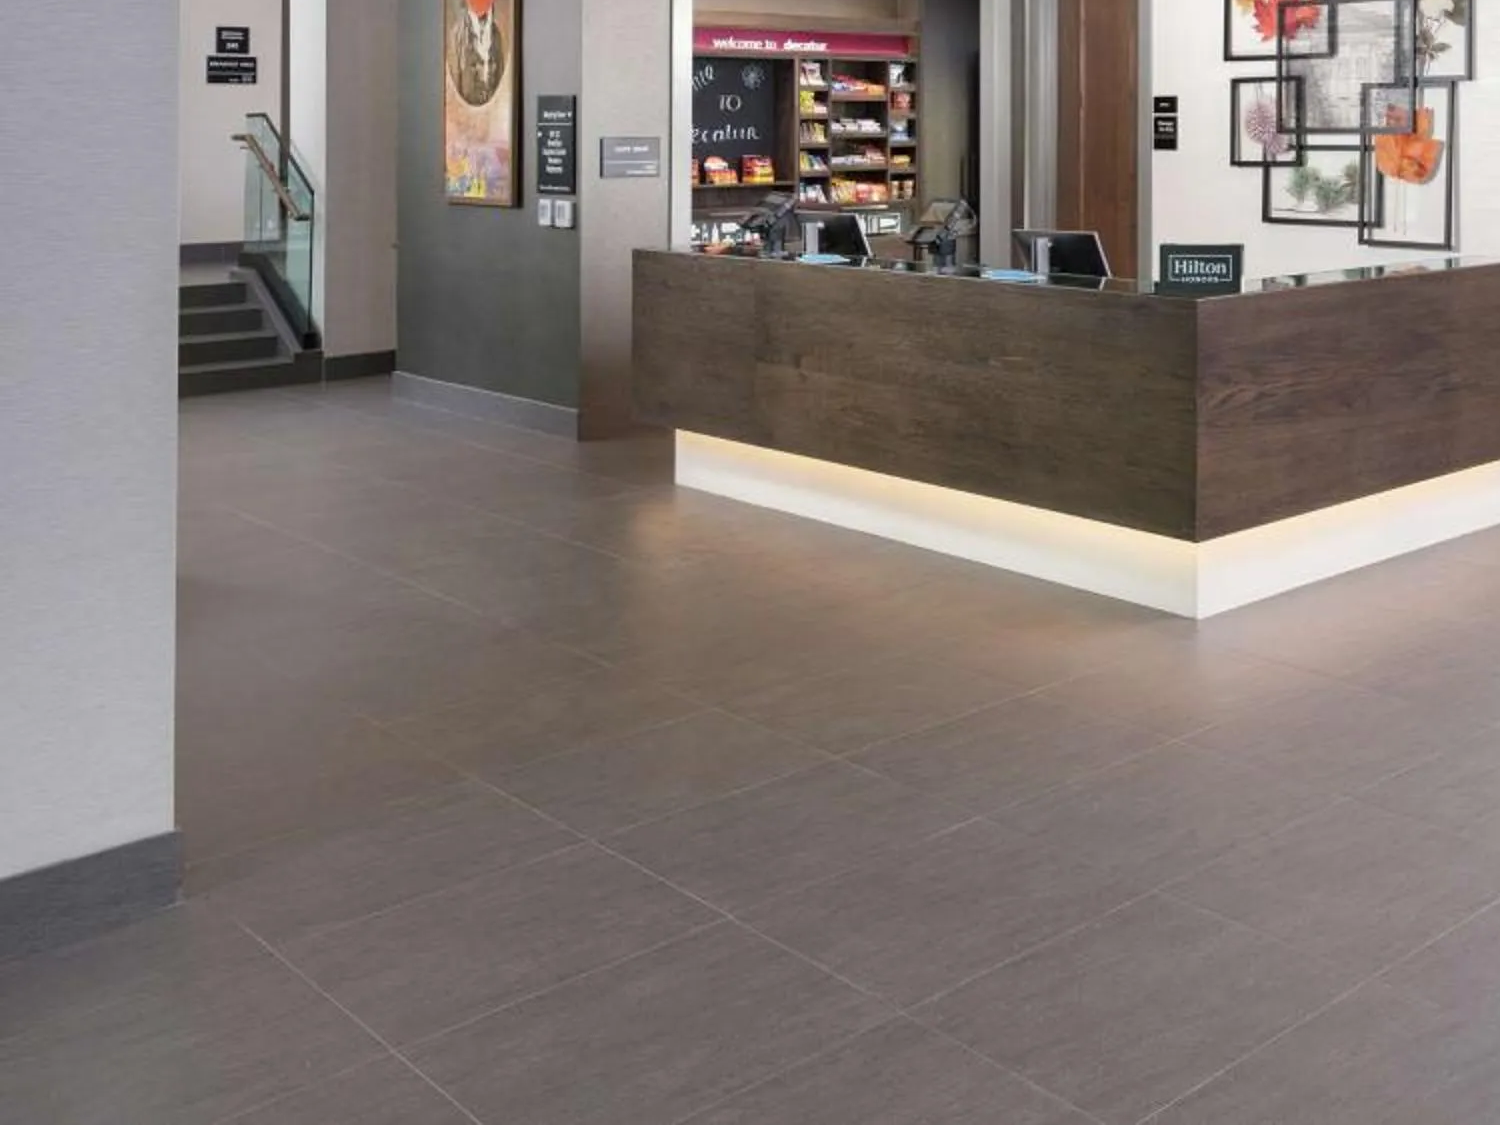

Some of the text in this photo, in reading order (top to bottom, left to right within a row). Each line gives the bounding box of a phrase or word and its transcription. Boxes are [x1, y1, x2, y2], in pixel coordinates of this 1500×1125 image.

[713, 36, 829, 51] welcome to decatur
[1174, 259, 1227, 274] Hilton
